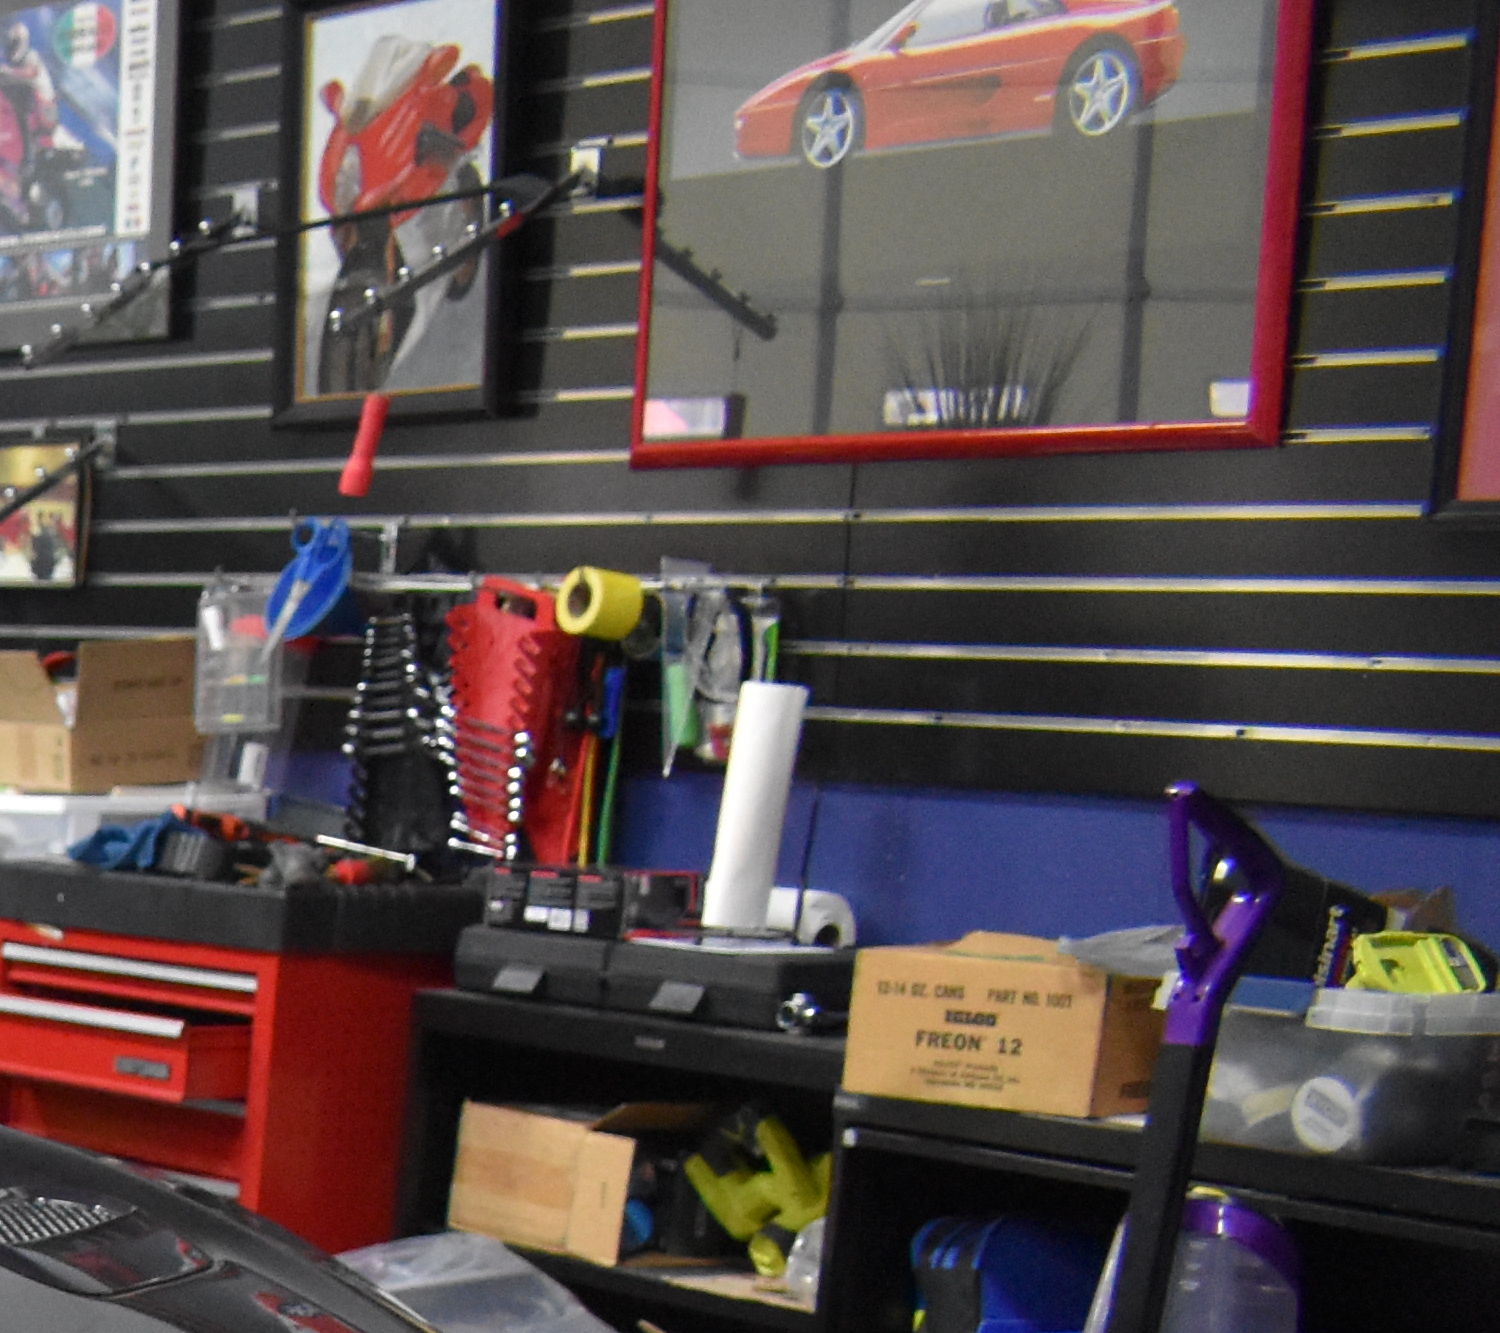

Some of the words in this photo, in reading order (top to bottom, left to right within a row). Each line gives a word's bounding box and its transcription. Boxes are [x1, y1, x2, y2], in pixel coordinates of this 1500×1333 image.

[935, 984, 965, 1000] CANS
[988, 988, 1017, 1004] PART
[998, 1037, 1024, 1056] 12
